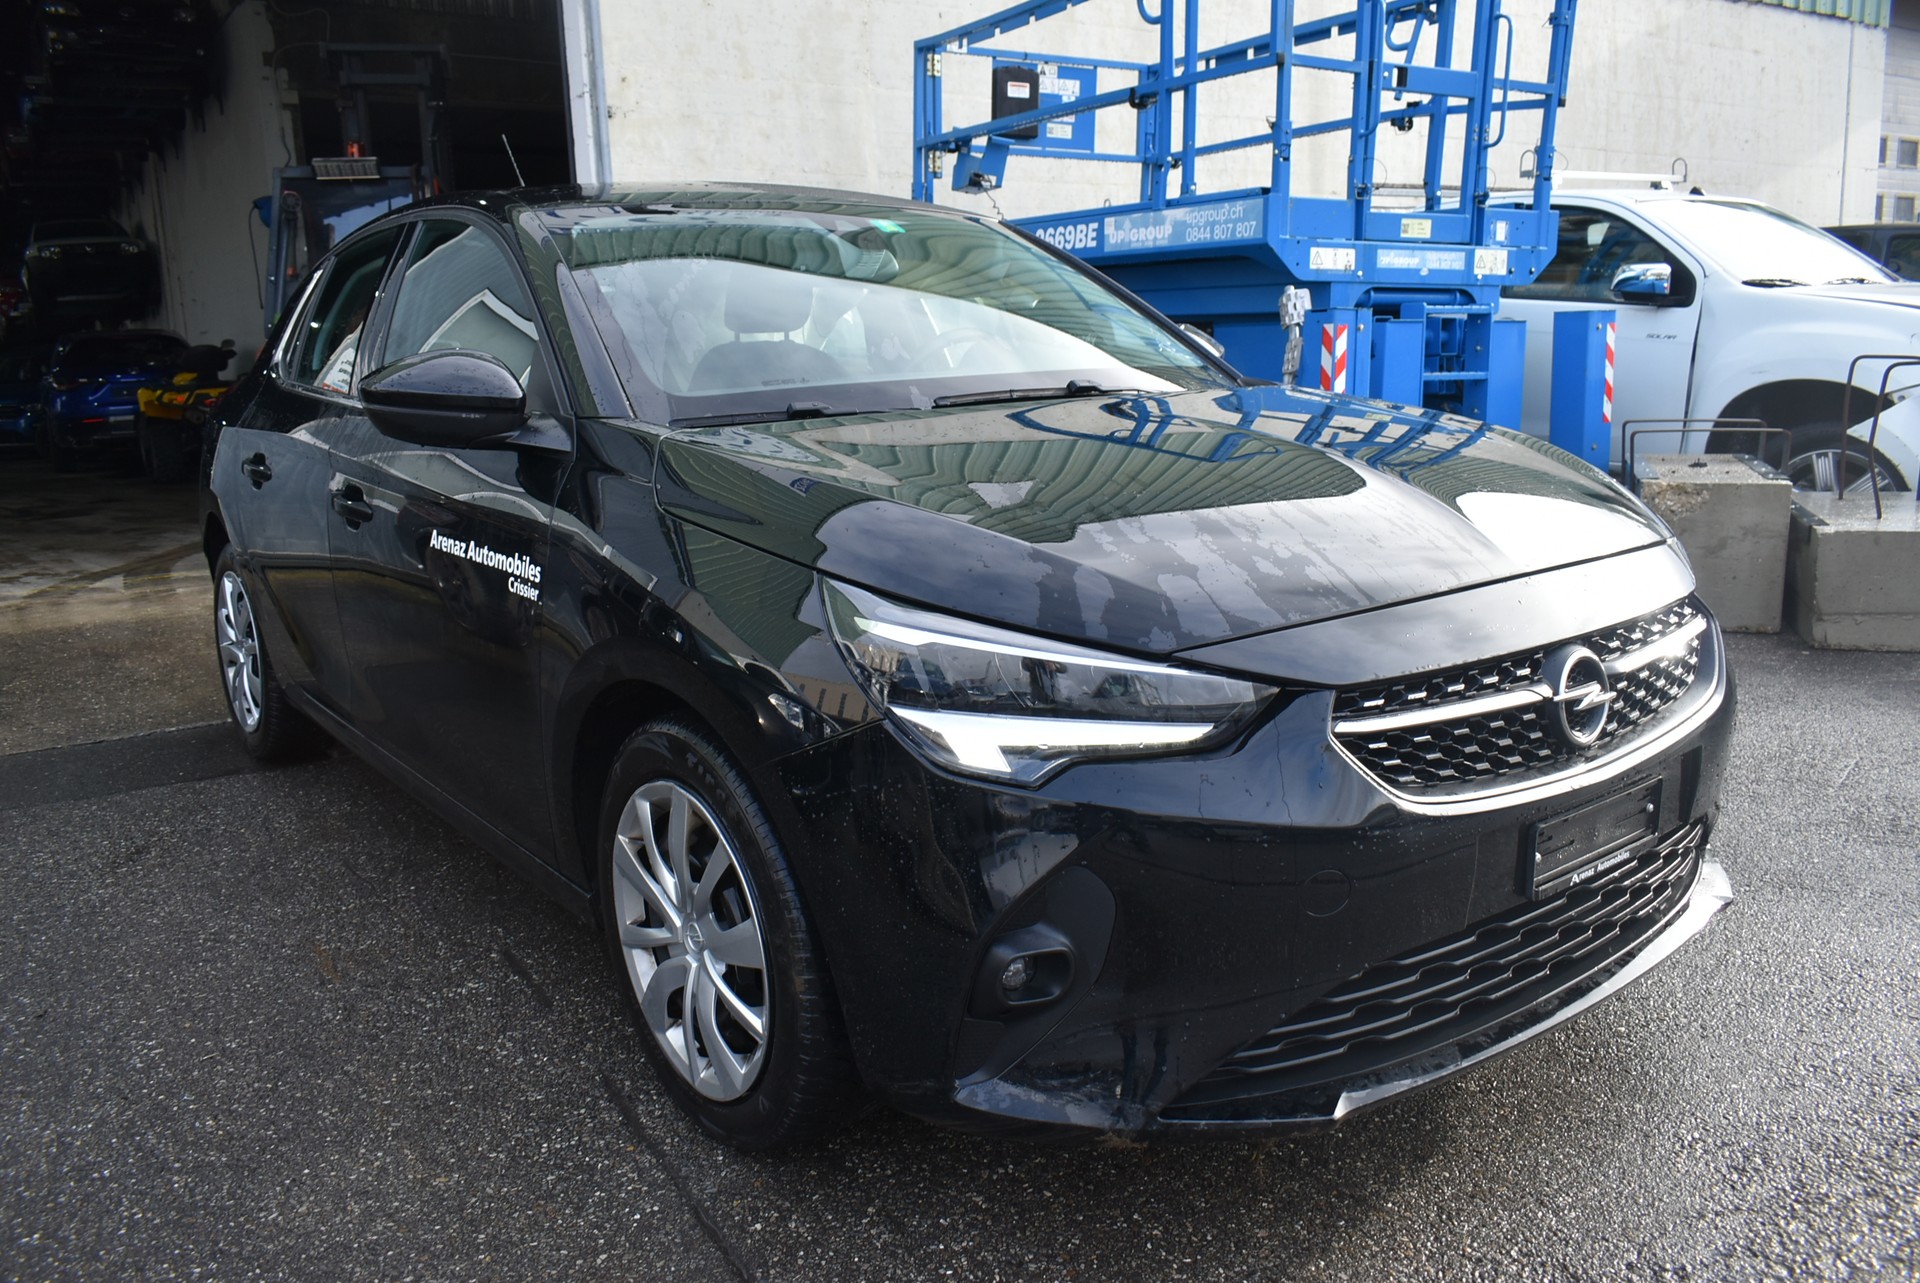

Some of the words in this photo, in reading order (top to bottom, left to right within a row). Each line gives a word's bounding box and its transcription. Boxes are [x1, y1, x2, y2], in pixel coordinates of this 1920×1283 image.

[1186, 203, 1244, 225] upgroup.ch
[1109, 229, 1124, 244] UP
[1130, 224, 1173, 243] GROUP
[1186, 226, 1212, 243] 0844
[1213, 223, 1233, 241] 807
[1236, 220, 1257, 238] 807
[430, 529, 466, 559] Arenaz
[466, 540, 541, 583] Automobiles
[508, 576, 539, 601] Crissier
[1570, 867, 1595, 886] Arenaz
[1597, 850, 1630, 872] Automobiles
